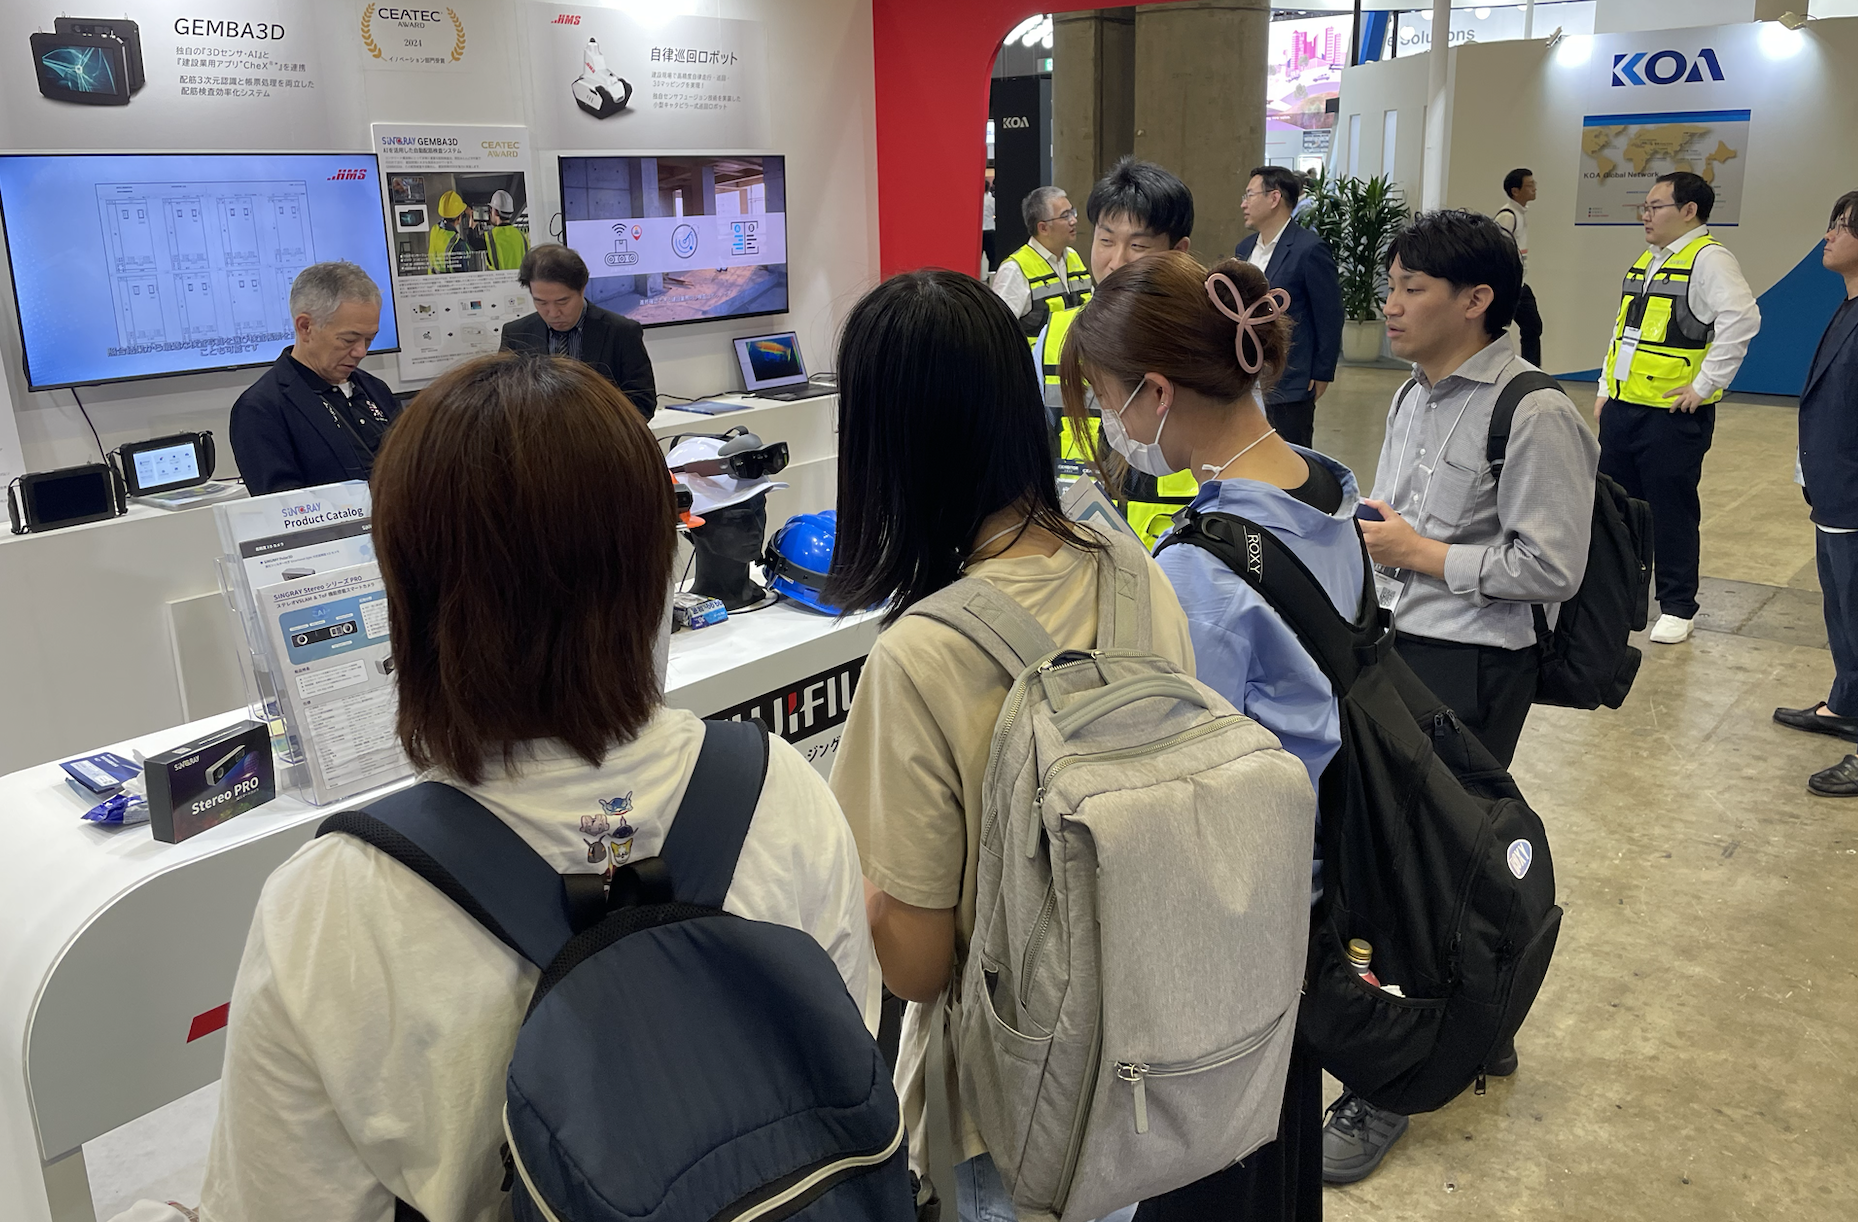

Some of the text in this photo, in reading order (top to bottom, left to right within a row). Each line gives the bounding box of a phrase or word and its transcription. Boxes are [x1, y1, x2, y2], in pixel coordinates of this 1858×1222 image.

[378, 8, 441, 22] CEATEC
[174, 17, 285, 40] GEMBA3D
[397, 21, 426, 29] AWARD
[1400, 29, 1475, 46] oluons
[650, 47, 738, 65] 自律巡回ロボット
[1611, 48, 1726, 87] KOA
[181, 87, 271, 98] 配筋検査効率化システム
[1002, 116, 1030, 129] KOA
[417, 137, 459, 146] GEMBA3D
[481, 141, 521, 149] CEATEC
[487, 150, 519, 158] AWARD
[1603, 171, 1626, 179] Global
[1627, 170, 1660, 179] Network
[284, 507, 364, 529] Product Catalog
[1247, 532, 1263, 575] ROXY
[303, 583, 325, 595] Stereo
[325, 578, 350, 590] シリーズ
[349, 575, 363, 586] PRO
[191, 791, 232, 816] Stereo
[233, 776, 260, 797] PRO
